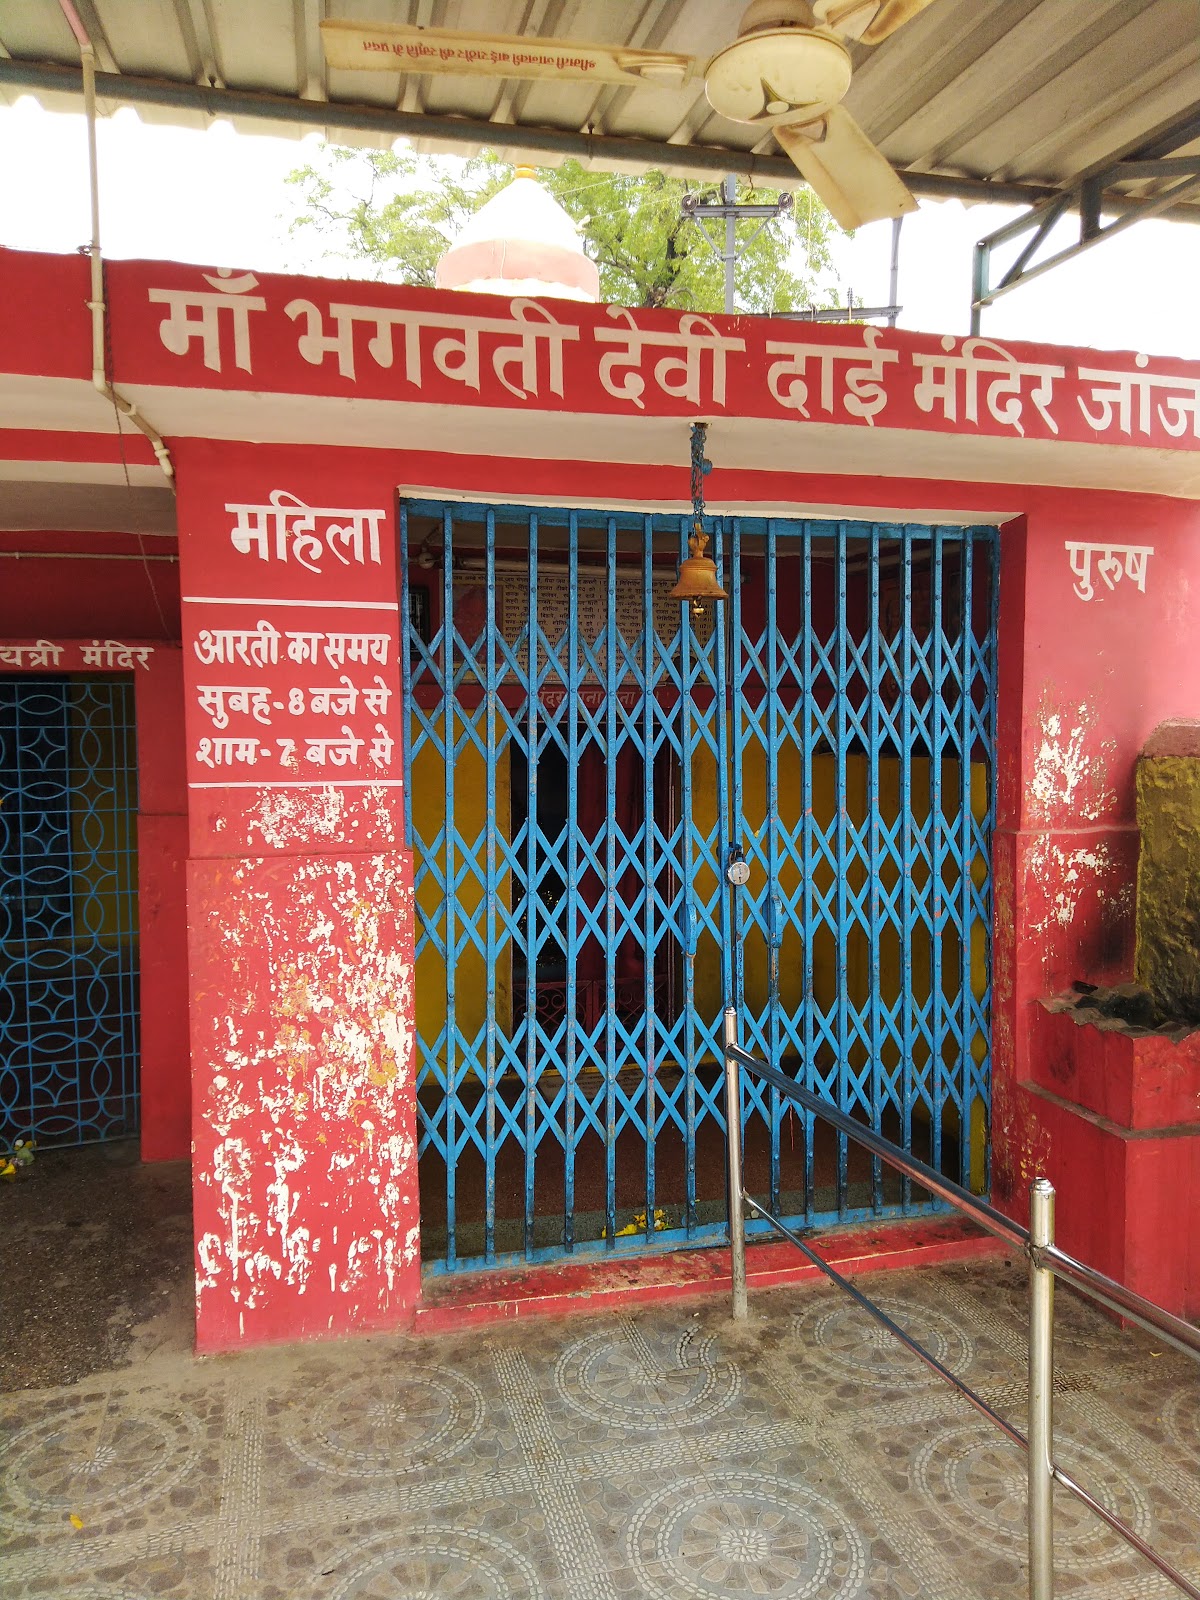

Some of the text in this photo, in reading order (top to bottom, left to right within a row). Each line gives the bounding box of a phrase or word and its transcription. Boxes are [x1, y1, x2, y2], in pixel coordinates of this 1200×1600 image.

[440, 48, 455, 61] की
[557, 56, 597, 72] श्रीमती
[149, 267, 266, 375] माँ
[284, 298, 580, 400] भगवती
[594, 304, 747, 410] देवी
[766, 327, 900, 427] दाई
[912, 334, 1066, 438] मंदिर
[225, 489, 387, 574] महिला
[80, 639, 155, 671] मंदिर
[194, 620, 392, 670] आरती का समय
[308, 675, 359, 716] बजे
[361, 675, 392, 717] से
[304, 725, 365, 767] बजे
